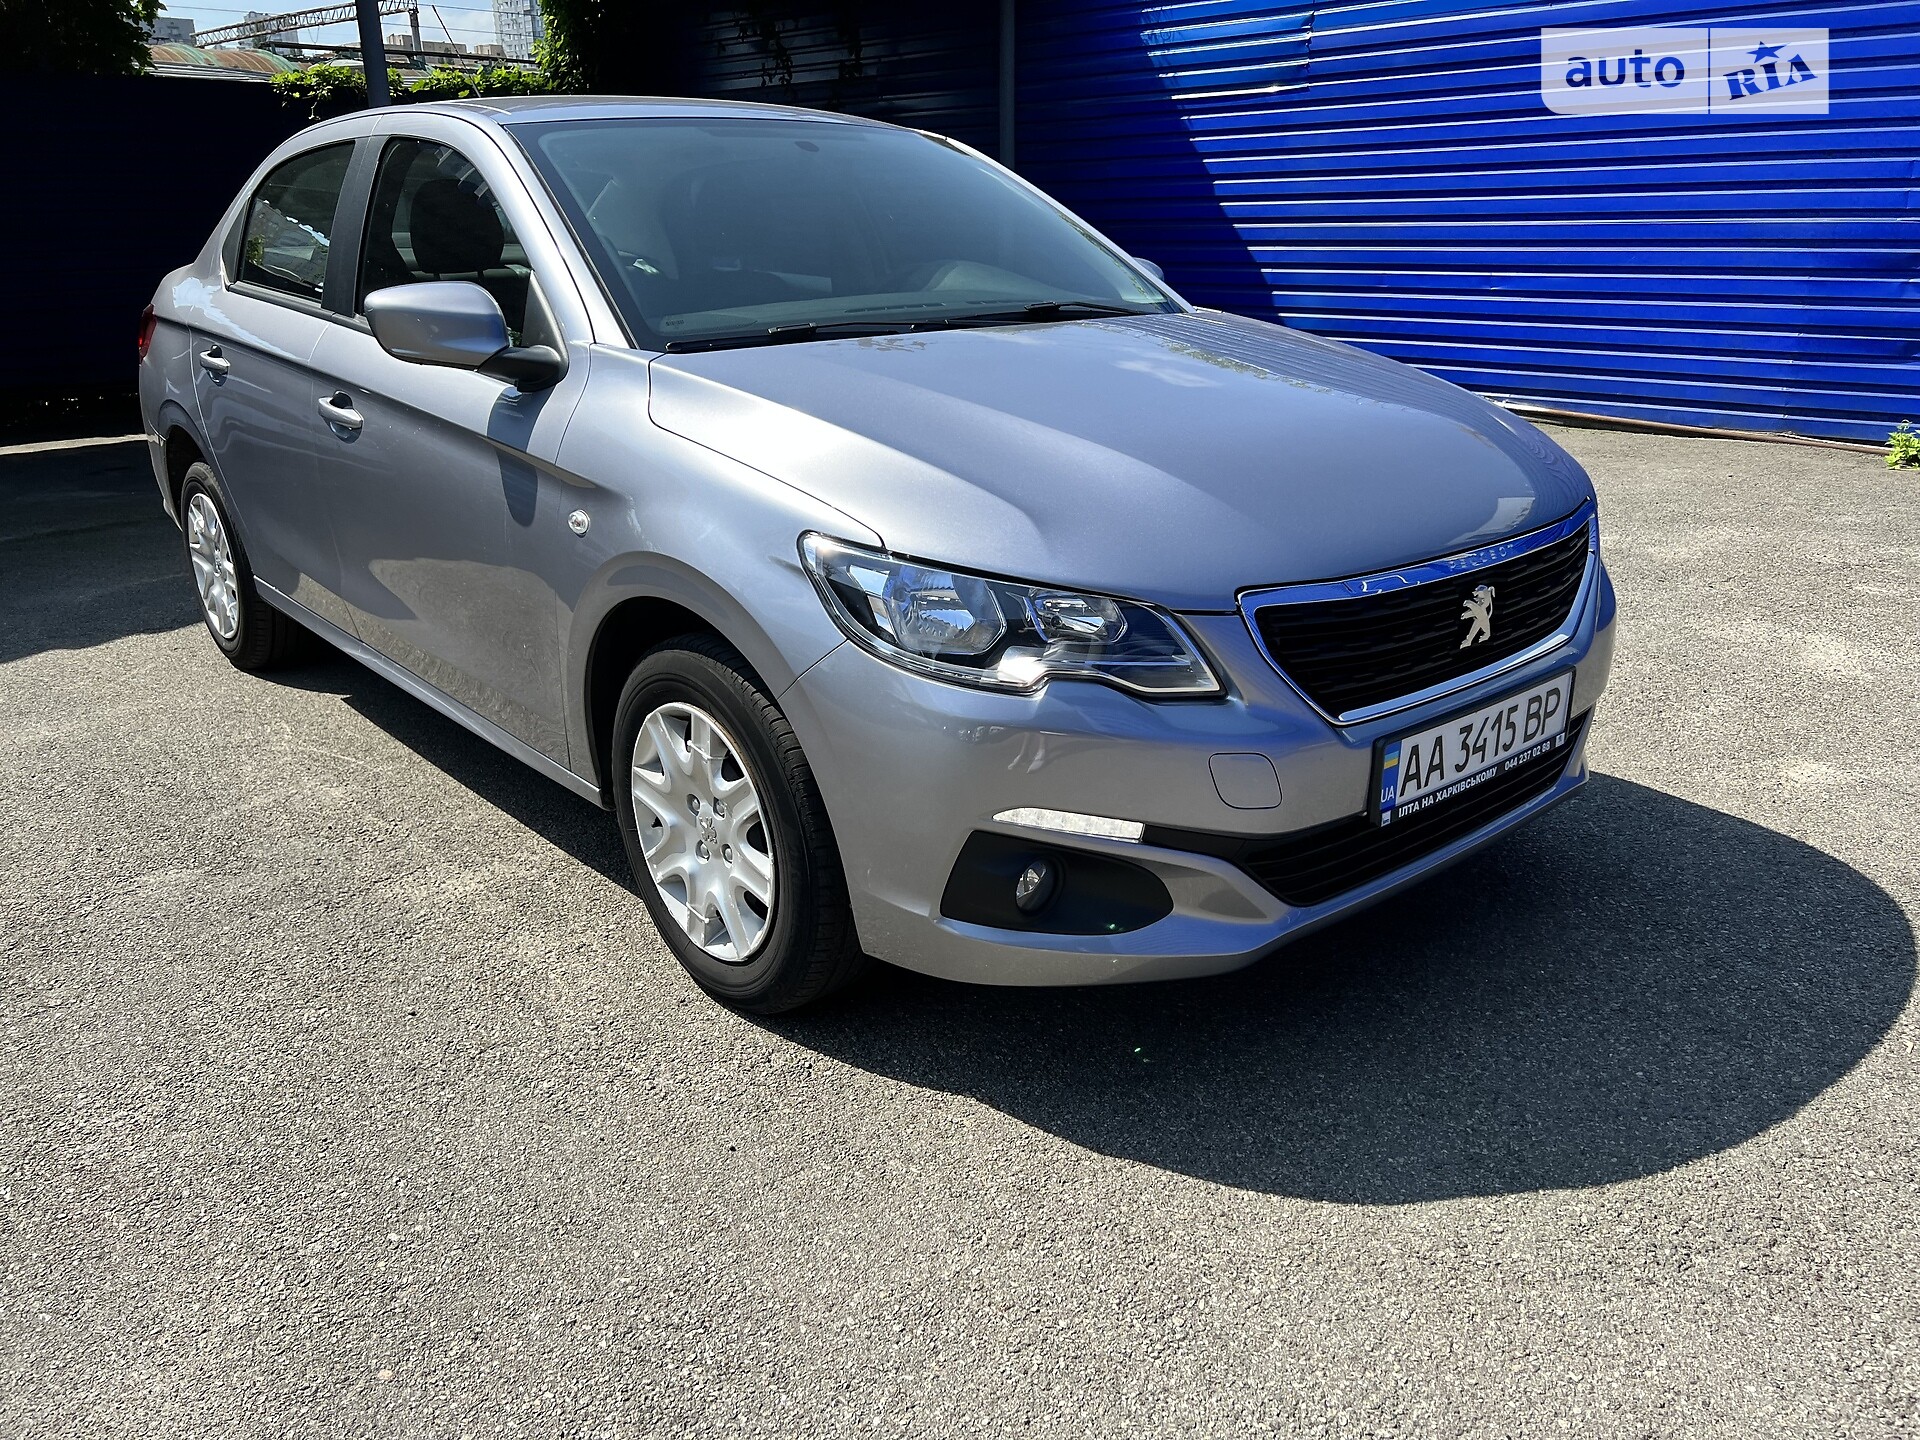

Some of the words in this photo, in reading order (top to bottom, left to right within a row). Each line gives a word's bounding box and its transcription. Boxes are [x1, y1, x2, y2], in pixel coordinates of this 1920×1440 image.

[1399, 735, 1445, 798] AA
[1455, 704, 1519, 773] 3415
[1523, 687, 1561, 743] BP
[1504, 757, 1518, 771] 044
[1519, 750, 1532, 765] 237
[1532, 745, 1542, 757] 02
[1381, 785, 1395, 803] UA
